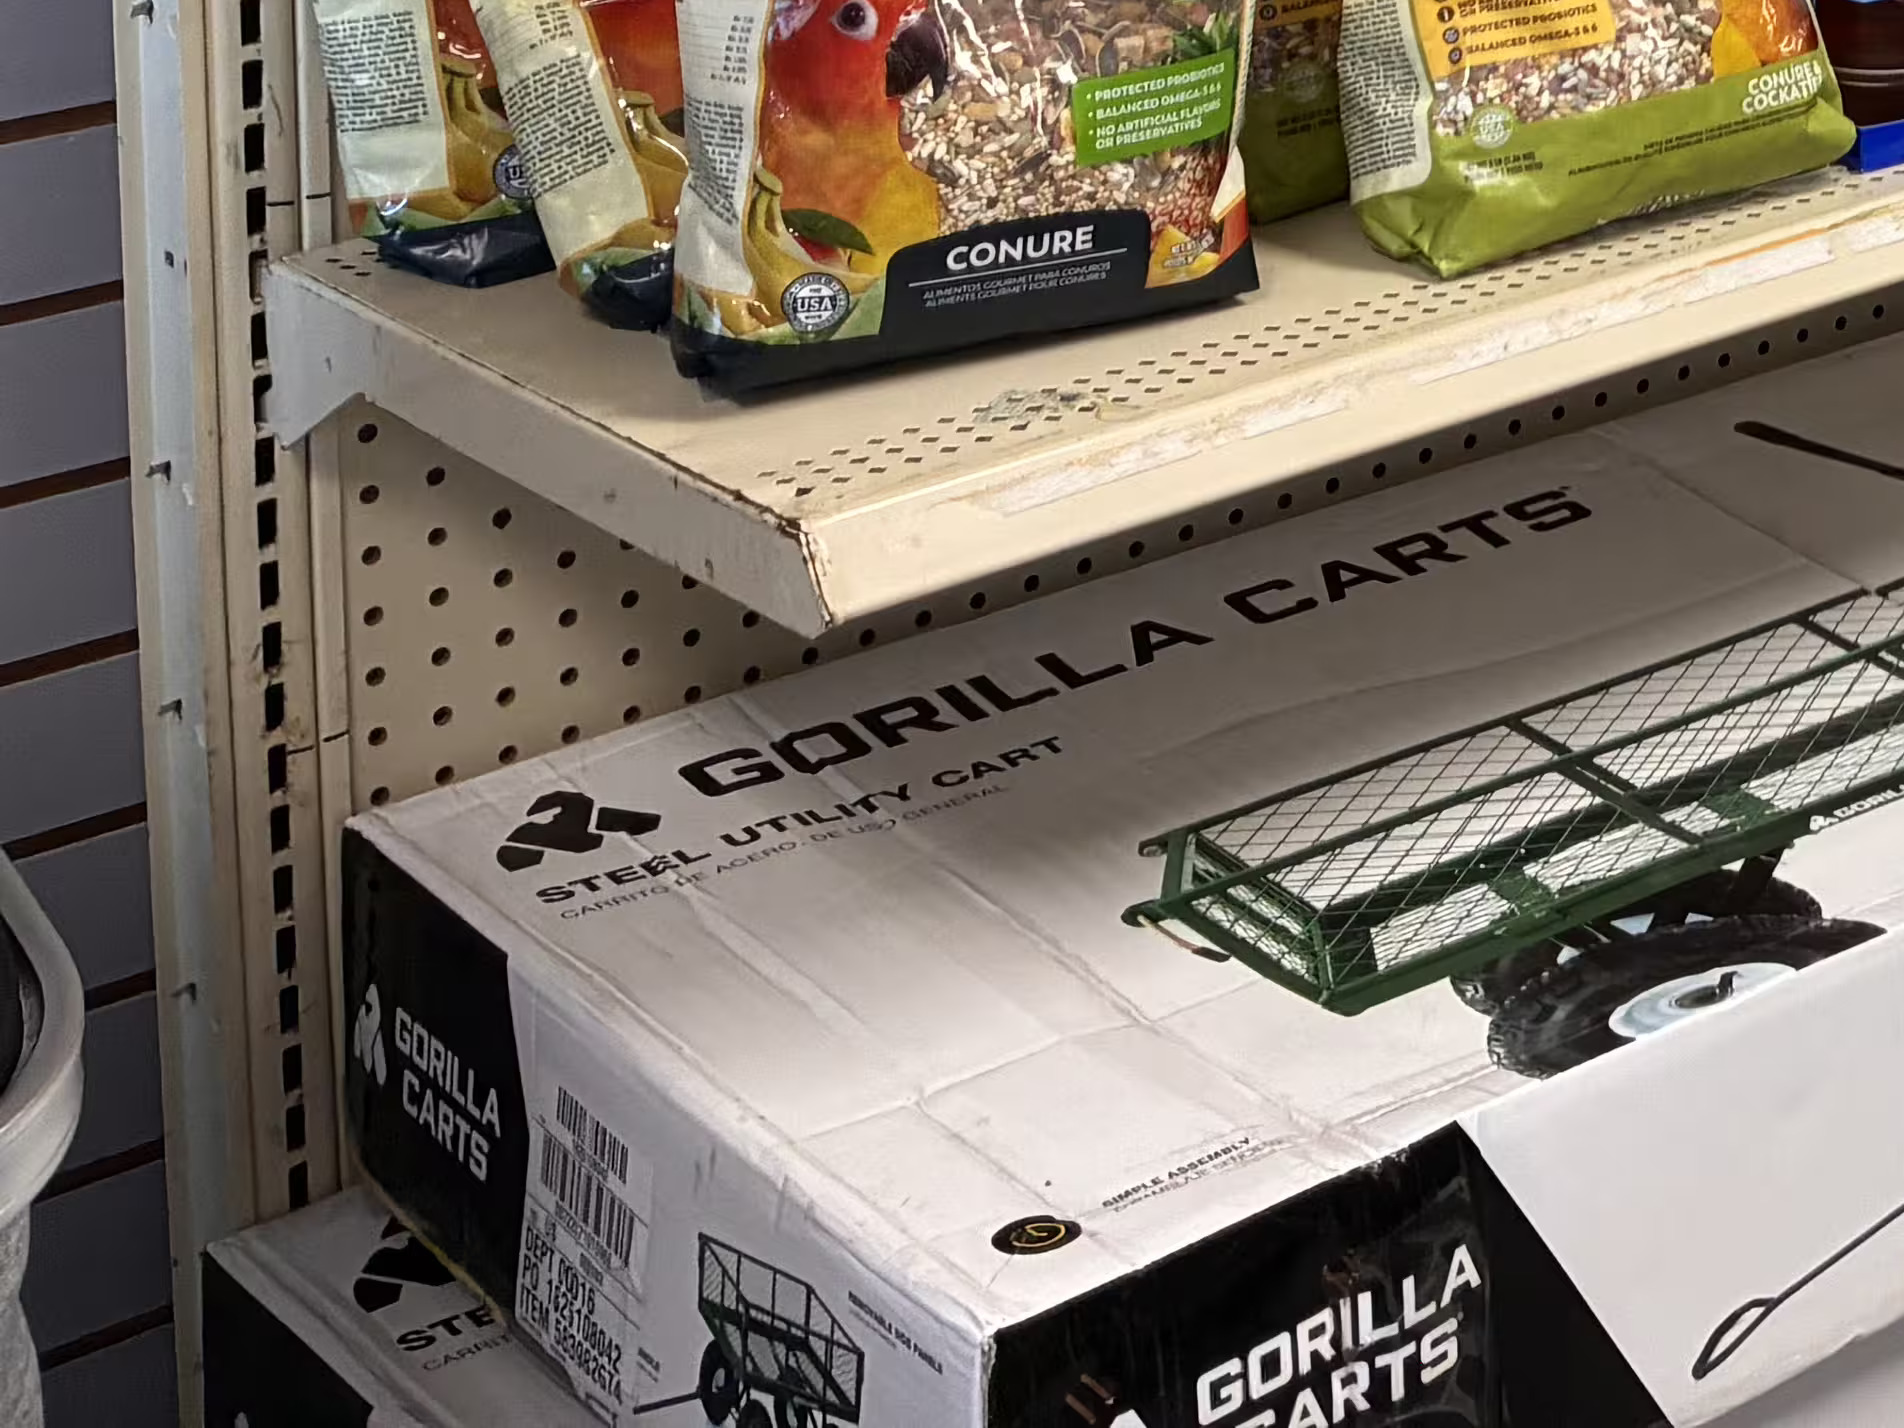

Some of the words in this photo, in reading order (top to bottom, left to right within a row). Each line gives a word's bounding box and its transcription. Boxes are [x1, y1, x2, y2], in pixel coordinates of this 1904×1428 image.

[1461, 17, 1531, 38] PROTECTED
[1531, 3, 1598, 25] PROBIOTICS
[1465, 37, 1527, 55] BALANCED
[1094, 78, 1165, 102] PROTECTED
[1747, 62, 1814, 96] CONURE
[1096, 98, 1159, 120] BALANCED
[1117, 111, 1179, 132] ARTIFICIAL
[1115, 118, 1203, 147] PRESERVATIVES
[946, 223, 1096, 272] CONURE
[795, 296, 834, 313] USA
[676, 619, 1216, 801] GORILLA
[1222, 485, 1595, 627] CARTS
[533, 848, 716, 908] STEEL
[717, 780, 914, 848] UTILITY
[929, 735, 1065, 789] CART
[393, 1006, 501, 1139] GORILLA
[402, 1068, 491, 1186] CARTS
[1195, 1242, 1483, 1427] GORILLA
